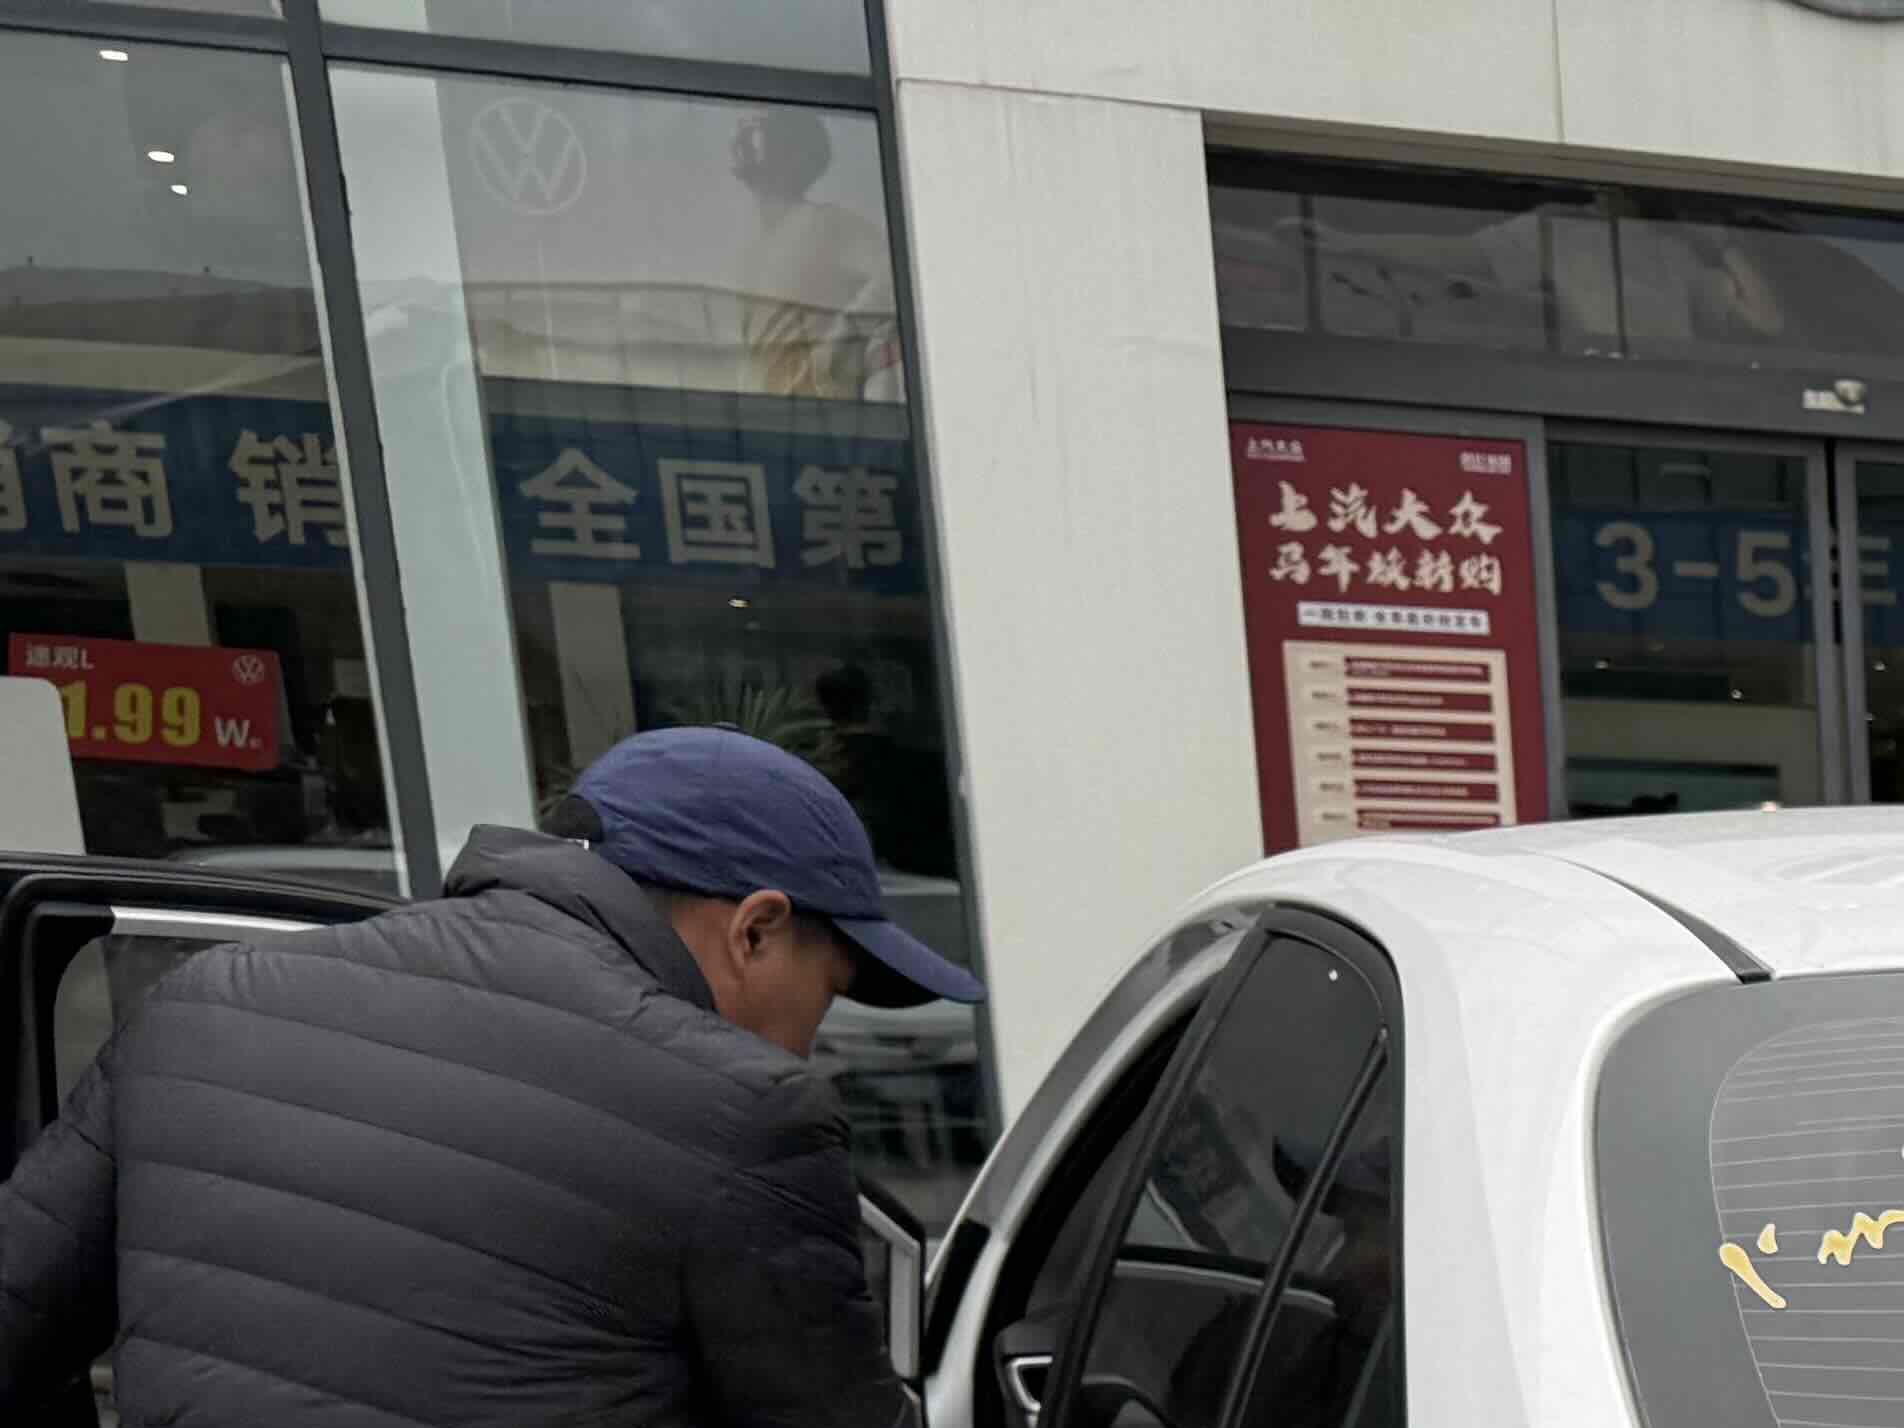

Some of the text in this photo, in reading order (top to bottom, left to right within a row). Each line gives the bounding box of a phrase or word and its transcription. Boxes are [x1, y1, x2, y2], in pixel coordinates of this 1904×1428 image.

[0, 422, 174, 539] 商
[519, 449, 903, 569] 全国第
[1269, 480, 1503, 544] 上汽大众
[1269, 541, 1502, 595] 马年焕新购
